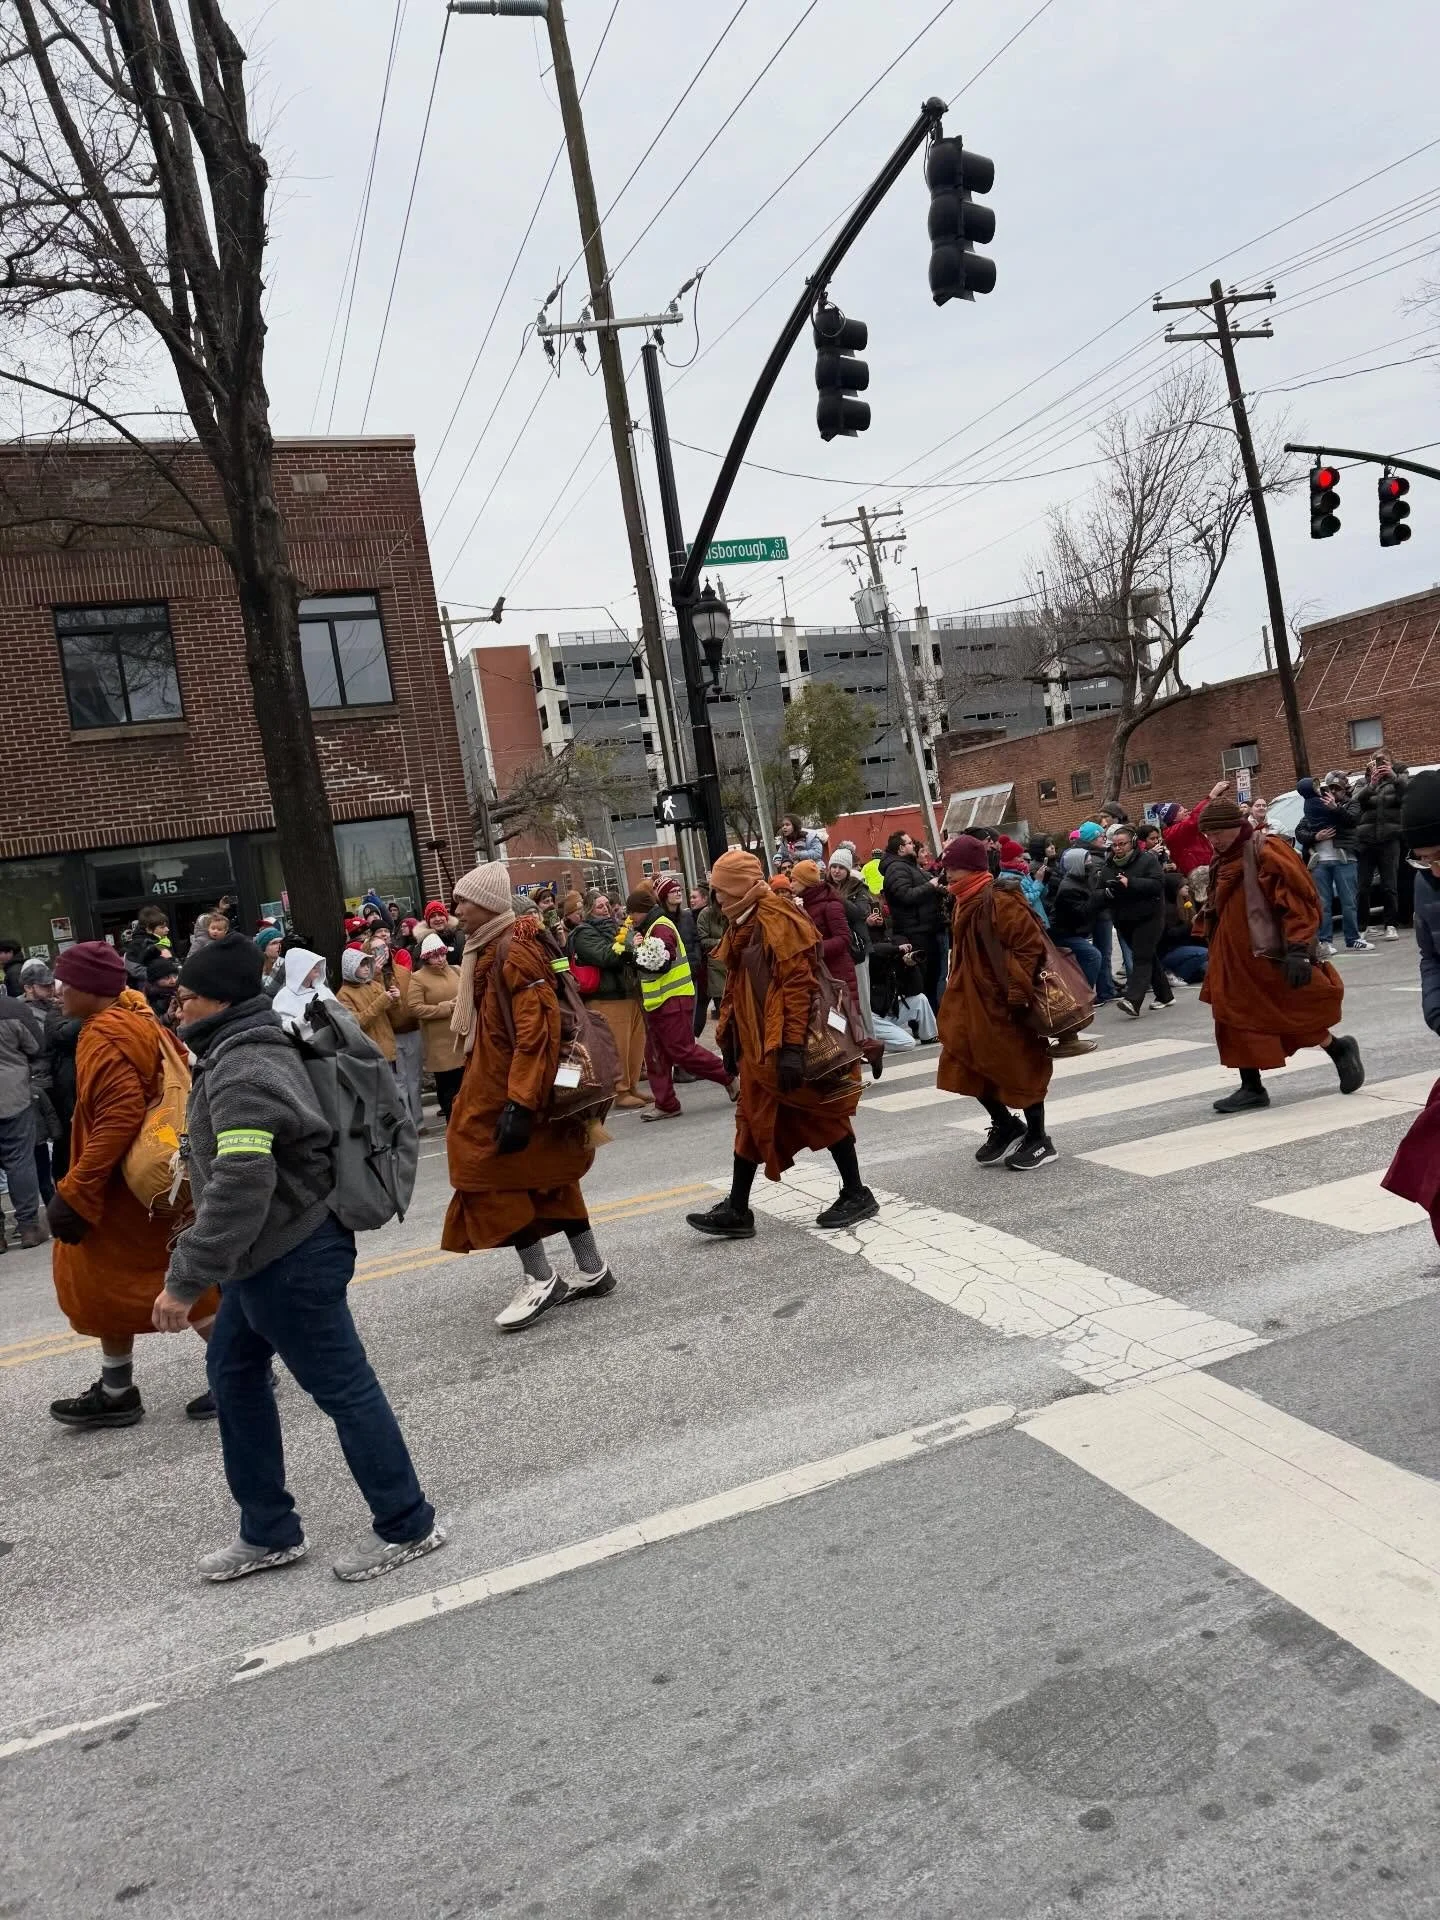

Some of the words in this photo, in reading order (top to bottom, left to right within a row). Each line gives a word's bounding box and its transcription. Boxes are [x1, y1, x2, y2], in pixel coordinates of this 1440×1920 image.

[774, 538, 784, 549] ST
[770, 549, 786, 559] 400
[152, 880, 178, 895] 415
